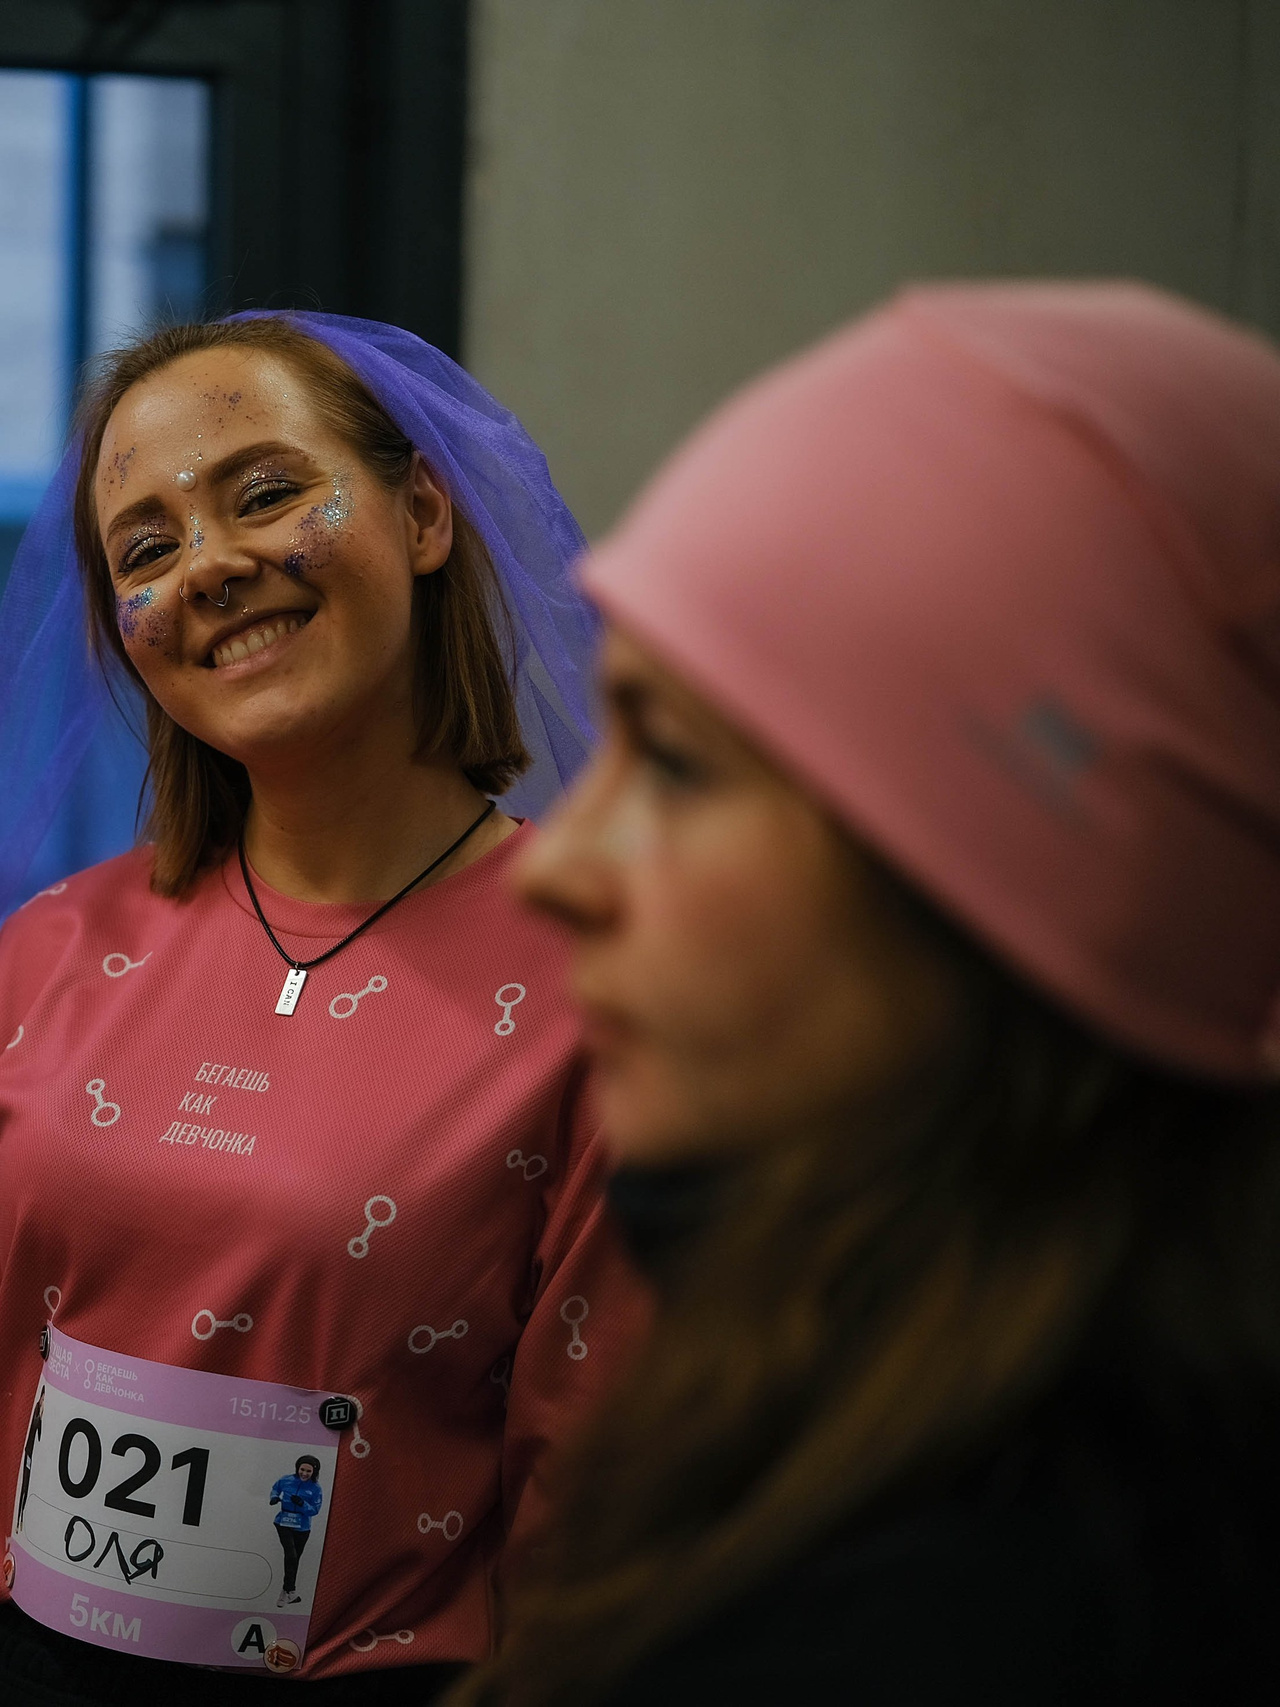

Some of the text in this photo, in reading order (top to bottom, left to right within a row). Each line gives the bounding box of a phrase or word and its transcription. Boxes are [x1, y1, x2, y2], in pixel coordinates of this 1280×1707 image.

[195, 1062, 270, 1092] БЕГАЕШЬ
[178, 1091, 217, 1115] КАК
[158, 1121, 257, 1156] ДЕВЧОНКА
[95, 1371, 114, 1385] КАК
[97, 1361, 138, 1381] БЕГАЕШЬ
[93, 1382, 145, 1403] ДЕВЧОНКА
[229, 1397, 312, 1424] 15.11.25
[58, 1417, 210, 1527] 021
[64, 1515, 164, 1585] ОЛЯ
